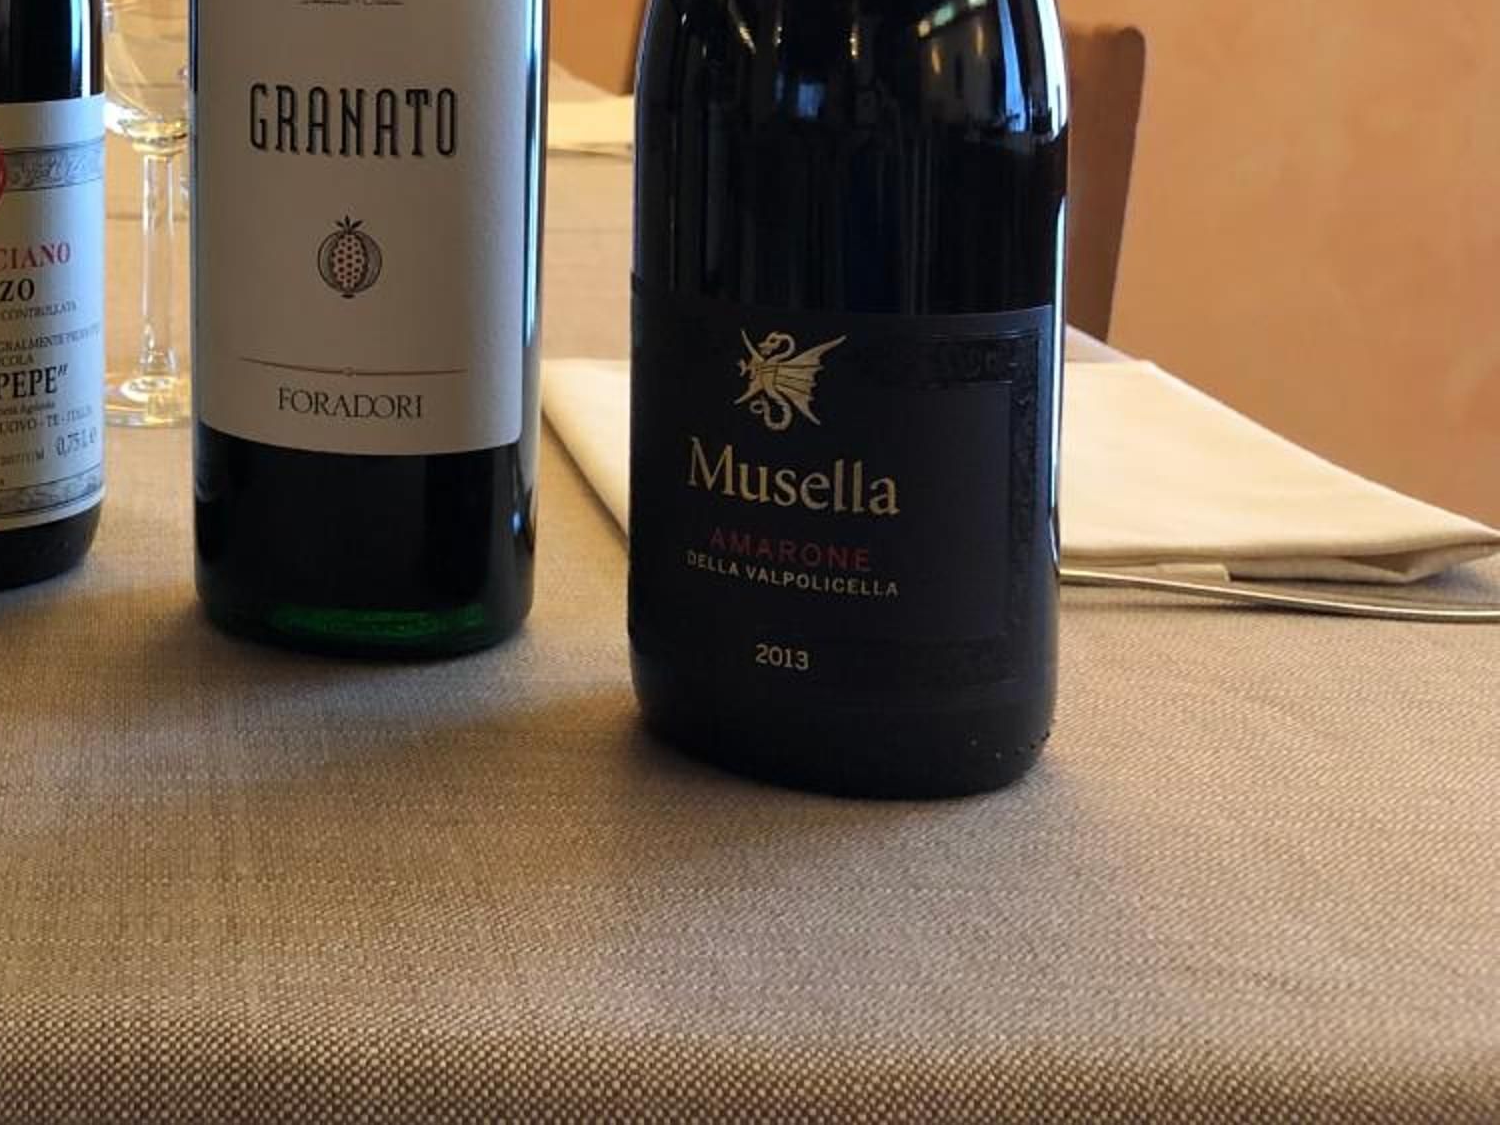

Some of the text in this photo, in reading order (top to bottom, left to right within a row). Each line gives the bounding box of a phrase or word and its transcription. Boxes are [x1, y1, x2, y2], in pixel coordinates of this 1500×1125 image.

[250, 82, 457, 157] GRANATO
[277, 386, 423, 419] FORADORI
[686, 436, 900, 516] Musella
[687, 549, 900, 597] DELLA VALPOLICELLA
[709, 527, 871, 573] AMARONE
[755, 642, 810, 672] 2013
